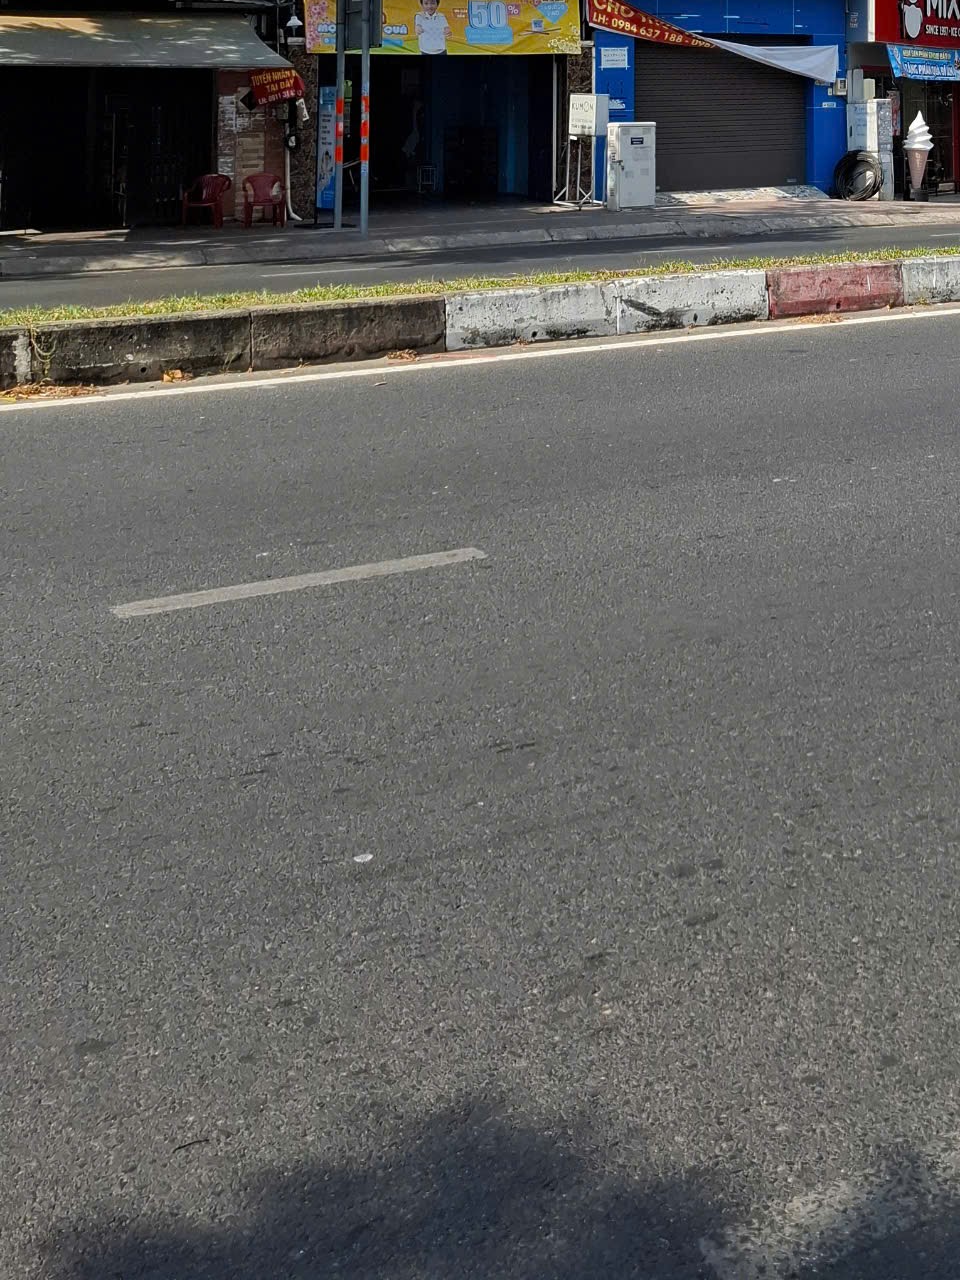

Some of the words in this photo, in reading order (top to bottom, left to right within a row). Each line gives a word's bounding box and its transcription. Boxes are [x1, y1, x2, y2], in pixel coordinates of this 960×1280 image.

[592, 11, 609, 25] LH:
[611, 18, 638, 33] 0984
[639, 28, 661, 39] 637
[663, 31, 684, 44] 188
[925, 25, 939, 35] SINCE
[950, 27, 958, 37] ICE
[251, 71, 272, 87] TUYỂN
[272, 70, 290, 81] NHÂN
[572, 101, 594, 113] KUMON
